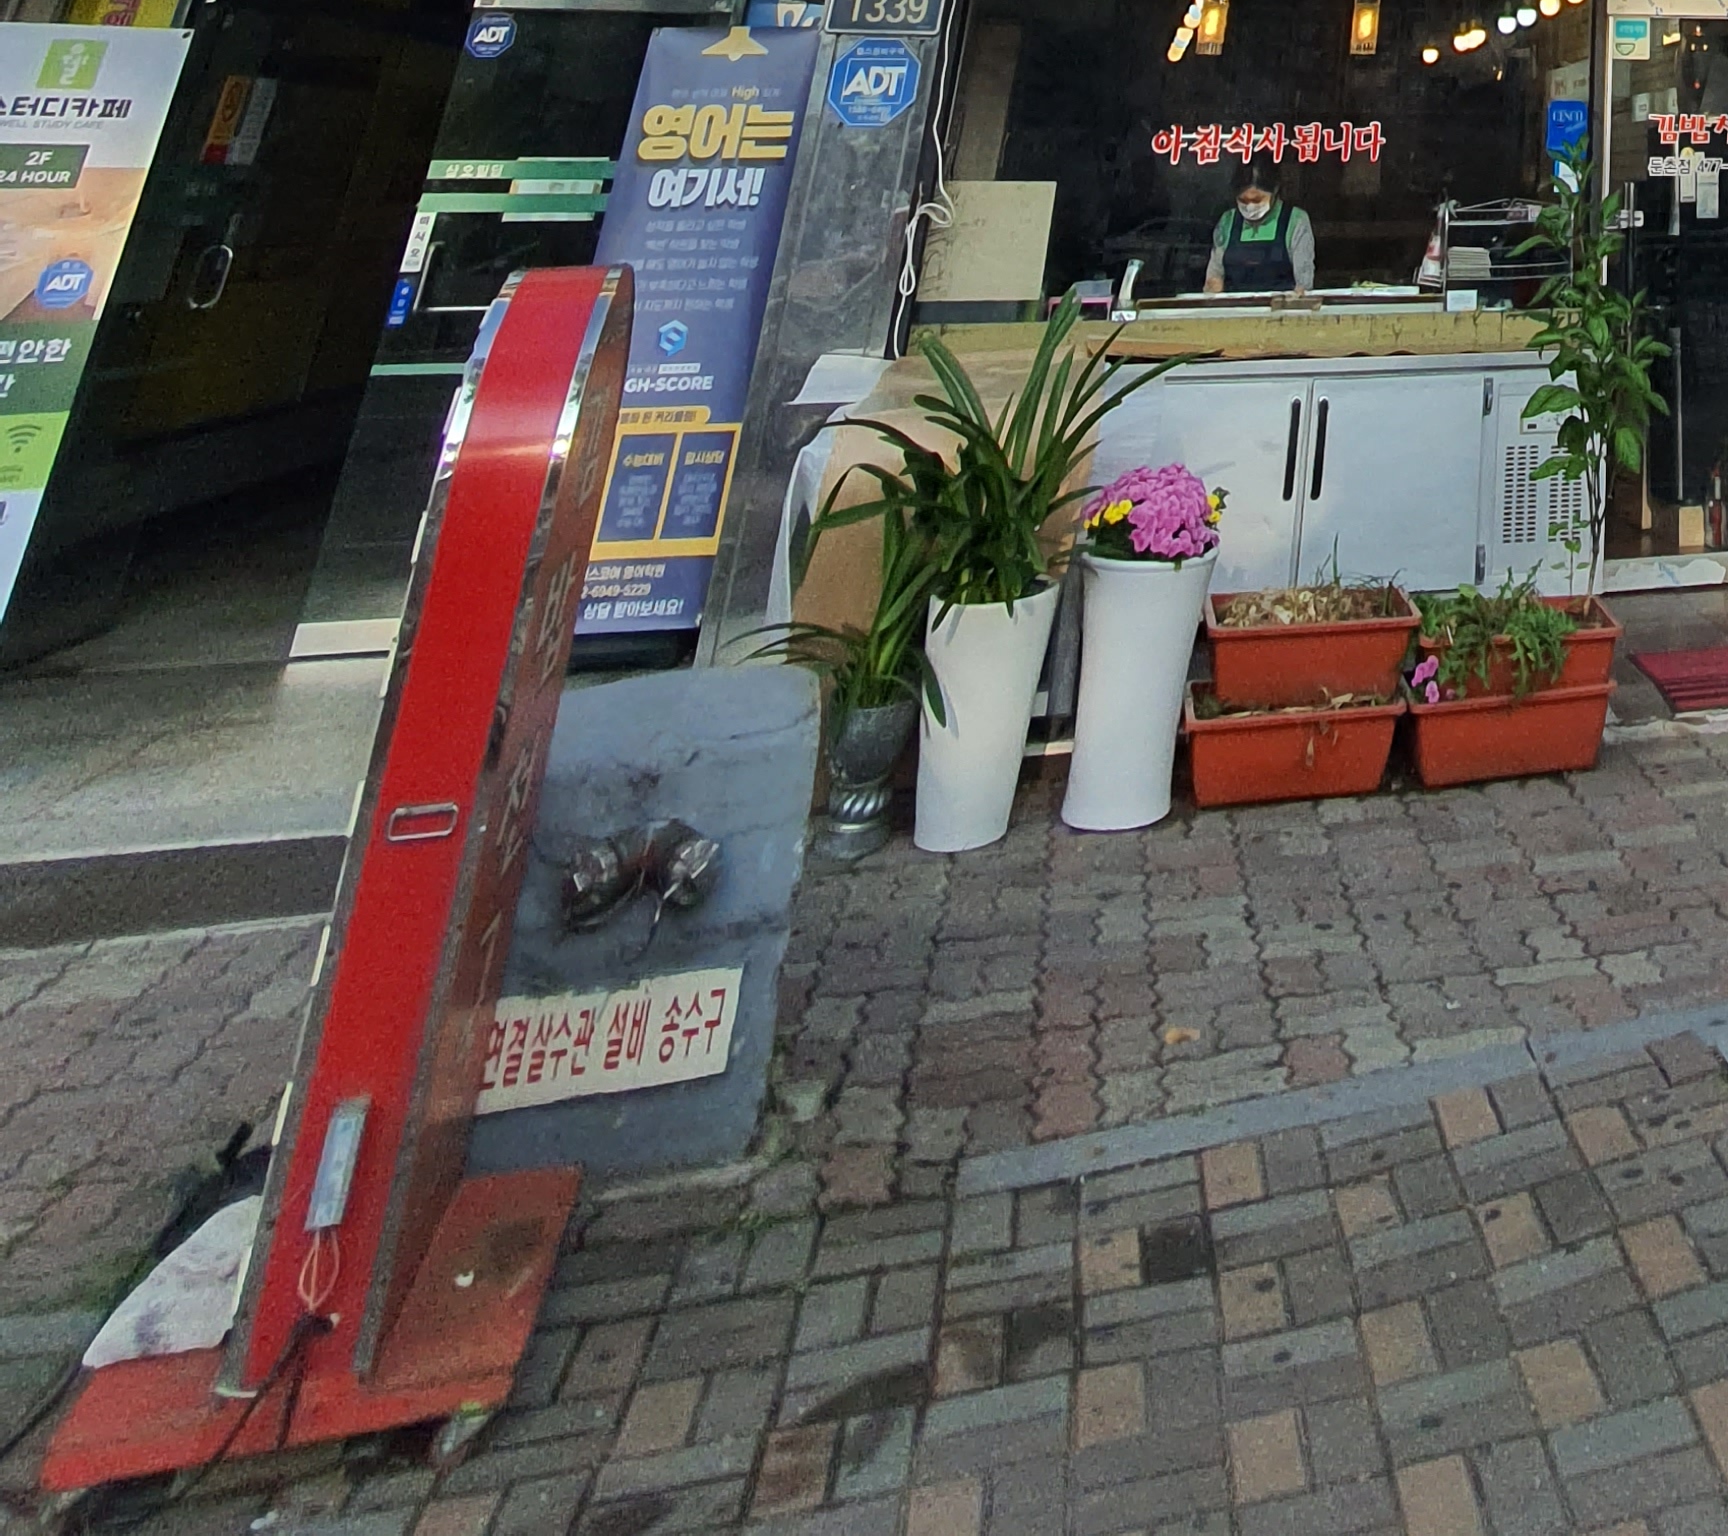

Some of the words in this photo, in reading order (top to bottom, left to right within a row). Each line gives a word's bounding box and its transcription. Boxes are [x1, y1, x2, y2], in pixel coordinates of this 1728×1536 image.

[473, 25, 511, 45] ADT
[842, 66, 907, 98] ADT
[731, 86, 760, 102] High
[637, 103, 796, 161] 영어는
[25, 151, 53, 166] 2F
[1647, 158, 1692, 177] 둔촌점
[20, 170, 72, 183] HOUR
[647, 167, 767, 209] 여기서!
[44, 272, 87, 292] ADT
[623, 375, 714, 394] GH-SCORE
[602, 997, 652, 1071] 설비
[658, 987, 727, 1064] 송수구
